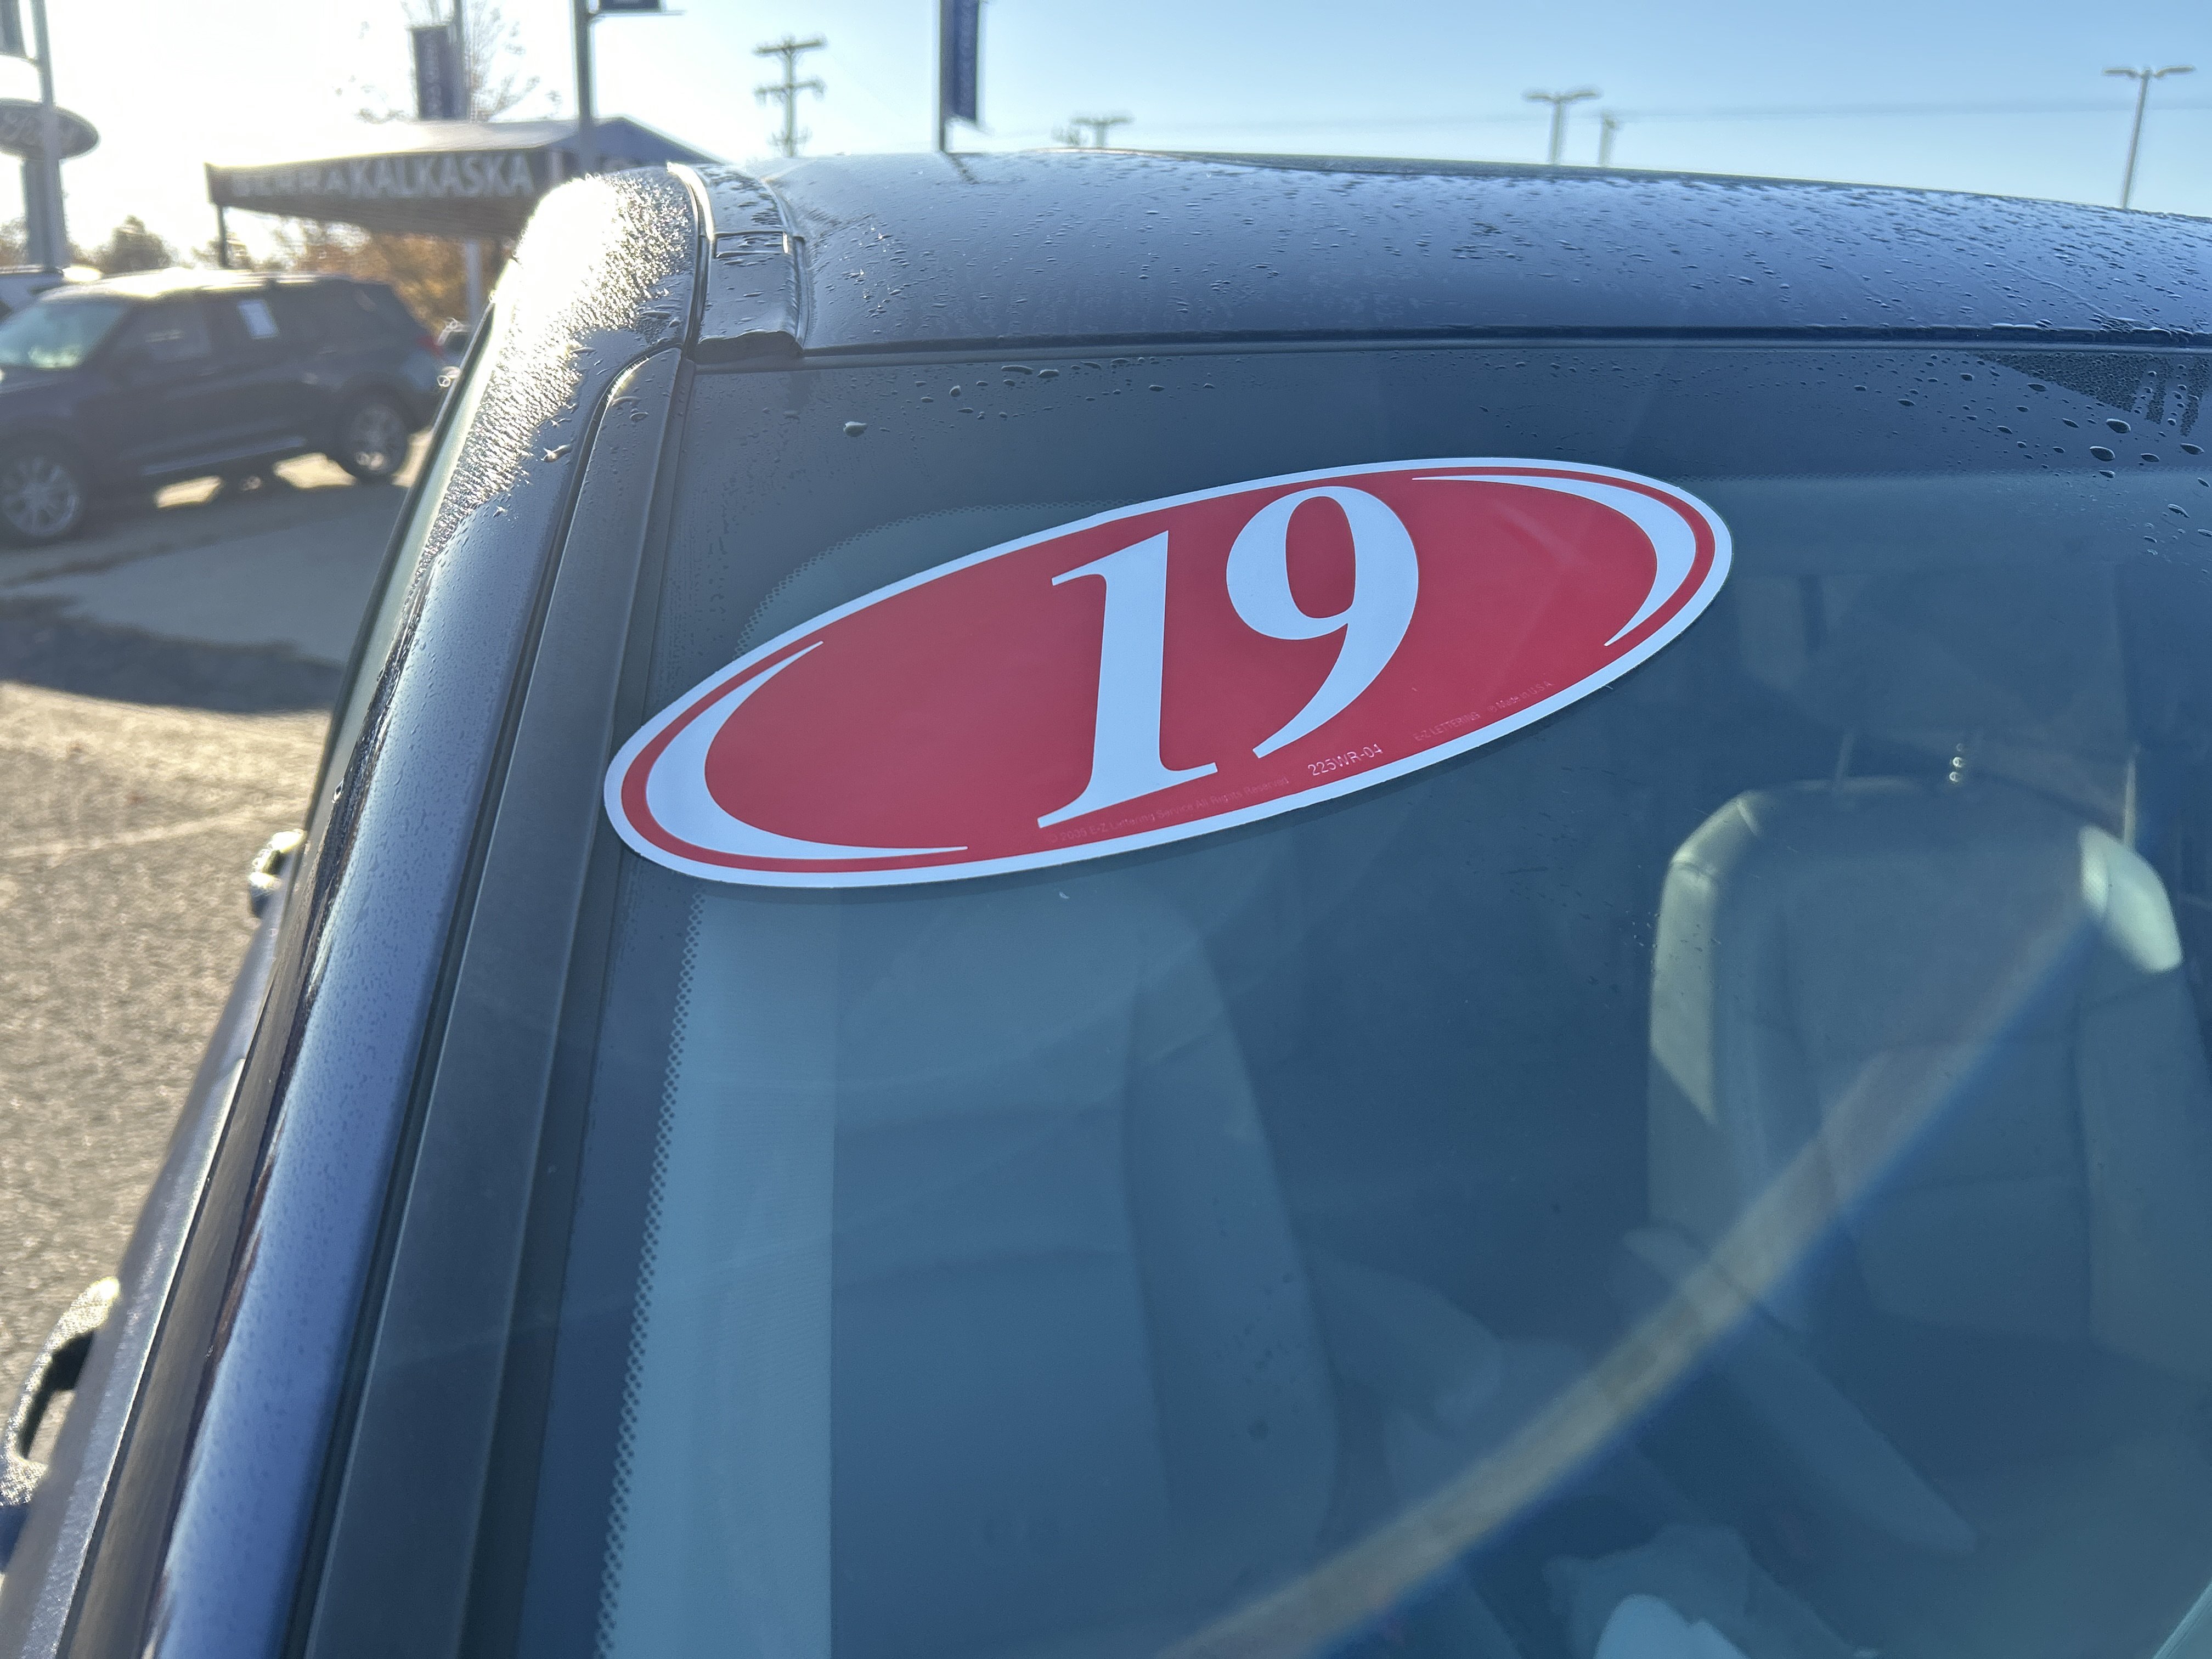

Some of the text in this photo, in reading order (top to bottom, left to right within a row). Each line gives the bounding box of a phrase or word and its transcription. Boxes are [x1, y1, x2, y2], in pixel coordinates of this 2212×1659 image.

[349, 153, 535, 199] KALKASKA
[1037, 486, 1419, 828] 19
[1307, 743, 1383, 776] 225WR-04
[1155, 804, 1194, 819] Service
[1195, 798, 1209, 809] All
[1243, 776, 1289, 796] Reserved
